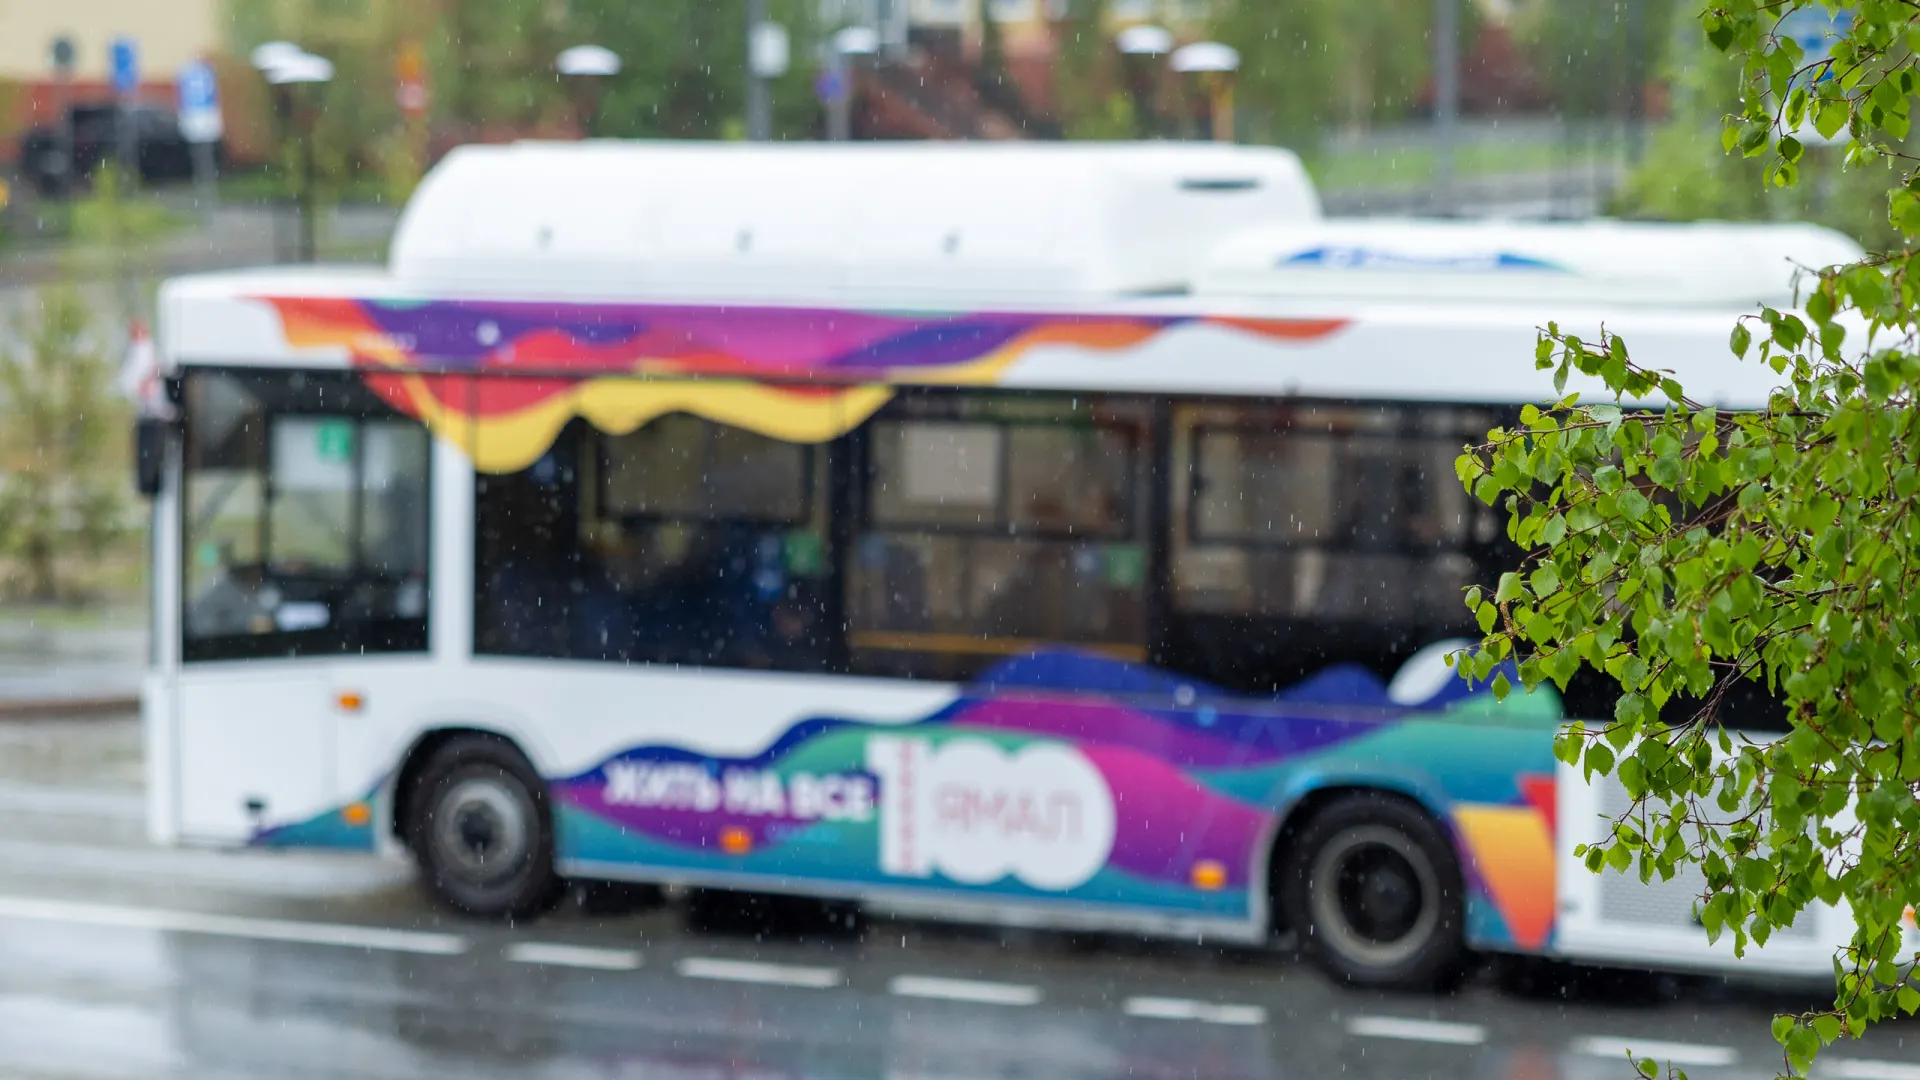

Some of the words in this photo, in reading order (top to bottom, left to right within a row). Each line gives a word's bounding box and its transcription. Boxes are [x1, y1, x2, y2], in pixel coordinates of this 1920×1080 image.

[606, 760, 720, 812] ЖИТЬ
[725, 766, 787, 817] НА
[792, 773, 877, 820] ВСЕ
[867, 736, 1118, 890] 100
[935, 782, 1085, 842] ЯМАЛ
